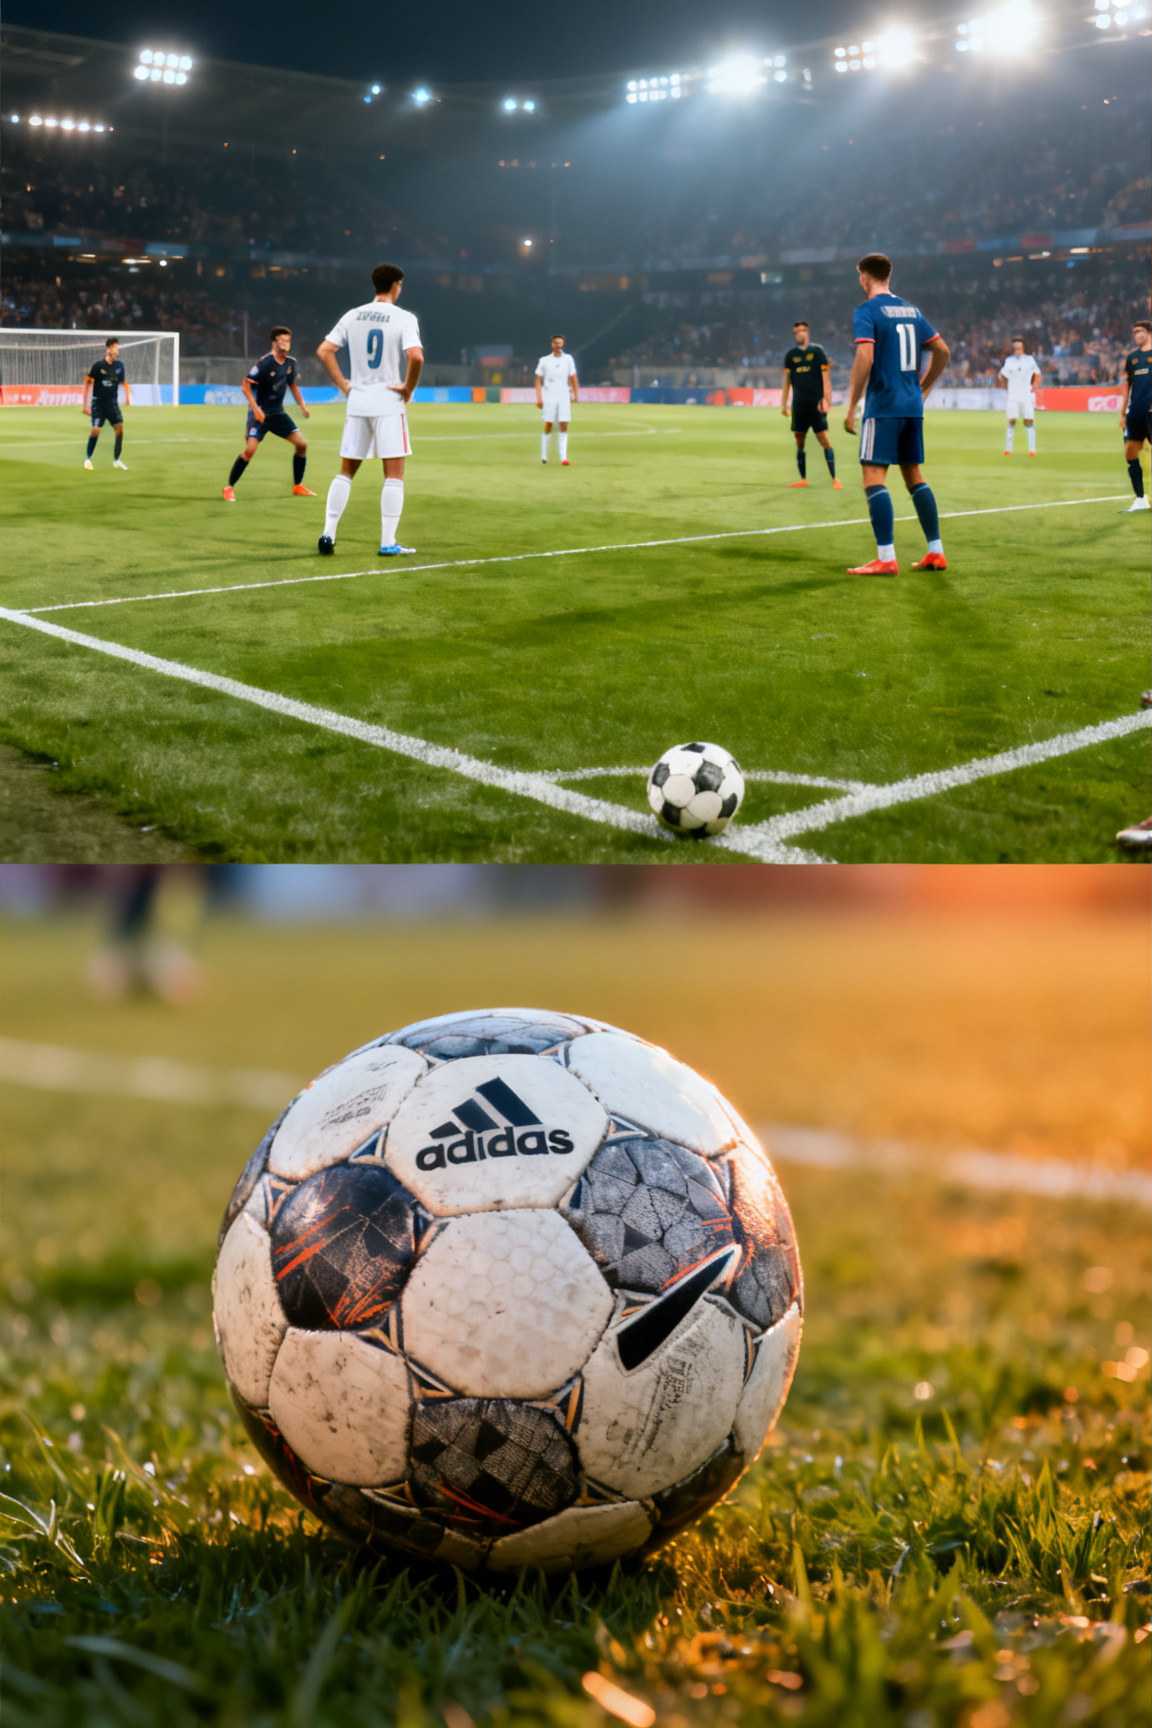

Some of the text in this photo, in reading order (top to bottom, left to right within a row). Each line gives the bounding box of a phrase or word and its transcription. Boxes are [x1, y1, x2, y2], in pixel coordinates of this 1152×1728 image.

[367, 328, 384, 370] 9
[896, 323, 917, 372] 11
[415, 1126, 574, 1171] adidas
